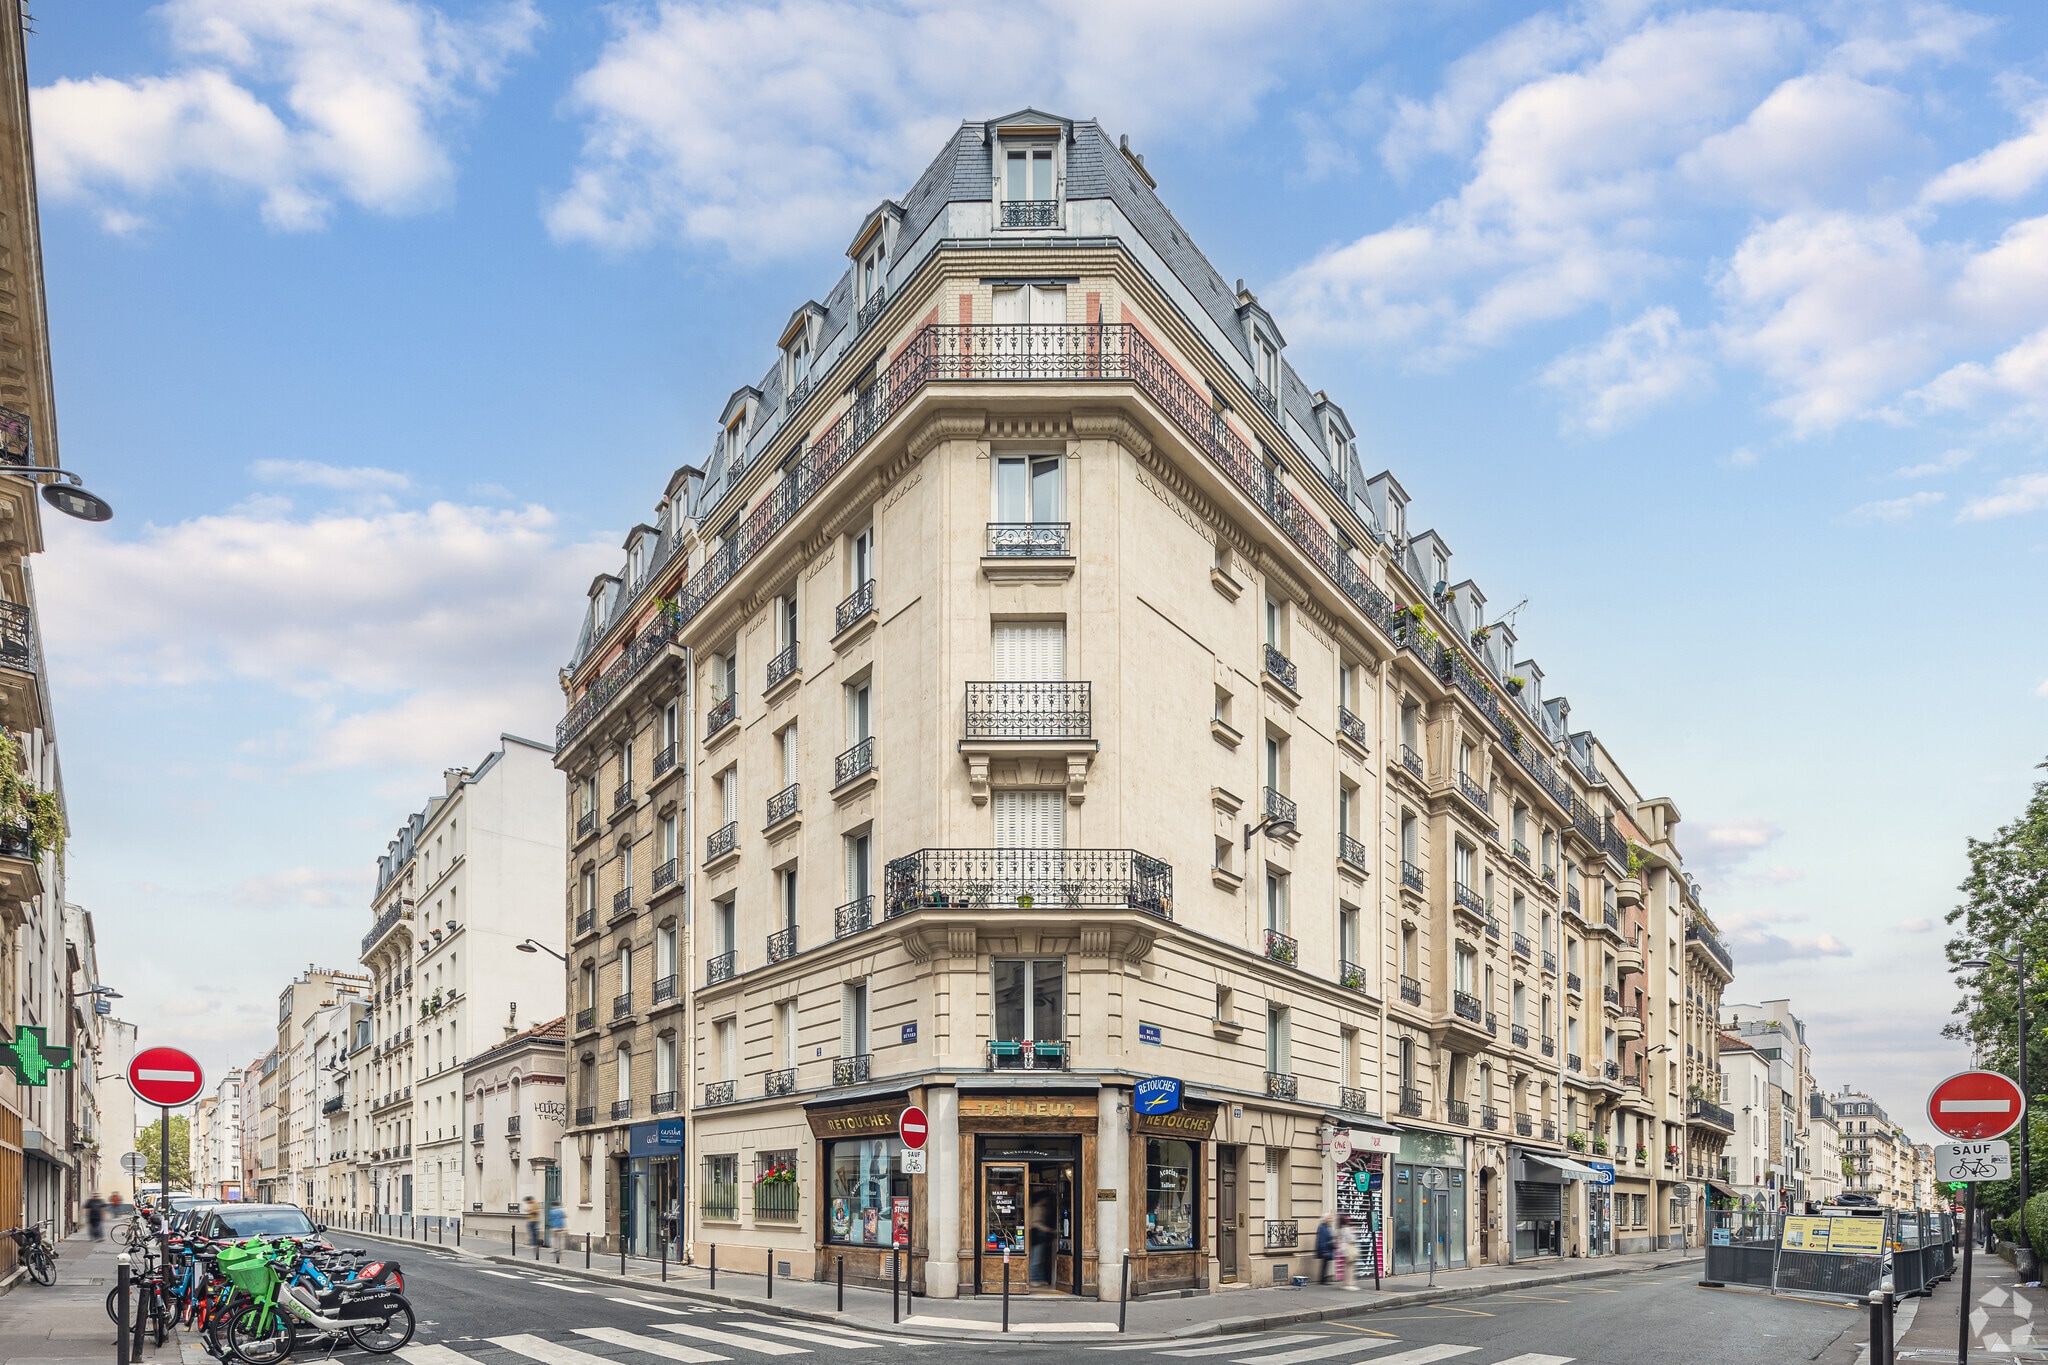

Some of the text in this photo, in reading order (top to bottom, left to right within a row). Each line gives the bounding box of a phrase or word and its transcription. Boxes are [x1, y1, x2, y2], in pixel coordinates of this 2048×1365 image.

[1138, 1079, 1177, 1095] RETOUCHES
[828, 1113, 892, 1131] RETOUCHES
[1146, 1115, 1211, 1131] RETOUCHES
[1334, 1141, 1346, 1149] CAVE
[1952, 1144, 1991, 1155] SAUF
[288, 1299, 312, 1319] Lime
